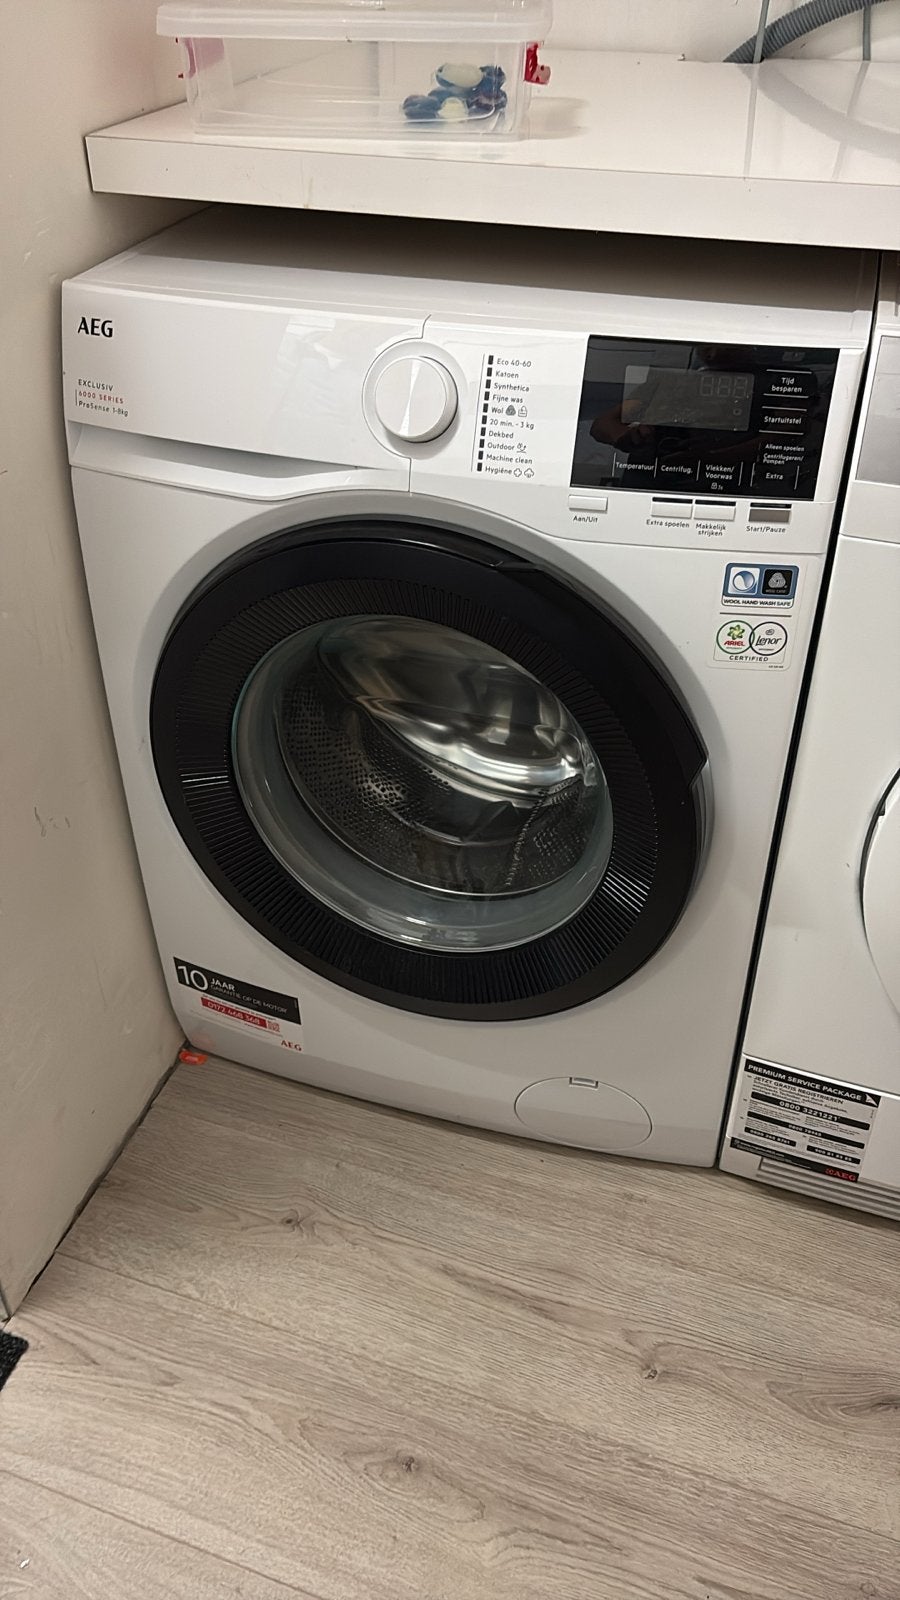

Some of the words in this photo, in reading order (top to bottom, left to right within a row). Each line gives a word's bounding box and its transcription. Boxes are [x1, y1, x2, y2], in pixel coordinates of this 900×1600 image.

[78, 316, 113, 338] AEG
[510, 360, 532, 368] 40-60
[496, 370, 519, 378] Katoen
[78, 379, 114, 392] EXCLUSIV
[782, 377, 794, 385] Tijd
[494, 382, 530, 392] Synthetica
[772, 384, 802, 393] besparen
[79, 390, 96, 398] 6000
[99, 394, 124, 404] SERIES
[492, 394, 508, 403] Fijne
[79, 400, 110, 412] ProSense
[764, 416, 802, 424] Startuitstel
[526, 422, 534, 430] kg
[489, 430, 514, 439] Dekbed
[488, 442, 515, 450] Outdoor
[486, 454, 514, 462] Machine
[616, 462, 654, 471] Temperatuur
[660, 464, 693, 474] Centrifug.
[706, 464, 734, 472] Vlekken/
[573, 515, 598, 523] Aan/Uit
[696, 523, 726, 531] Makkelijk
[755, 635, 782, 646] Lenor
[178, 966, 208, 991] 10
[210, 978, 235, 992] JAAR
[281, 1040, 302, 1051] AEG
[748, 1064, 786, 1080] PREMIUM
[788, 1076, 820, 1089] SERVICE
[822, 1085, 862, 1100] PACKAGE
[779, 1100, 800, 1111] 0800
[834, 1170, 856, 1181] AEG
